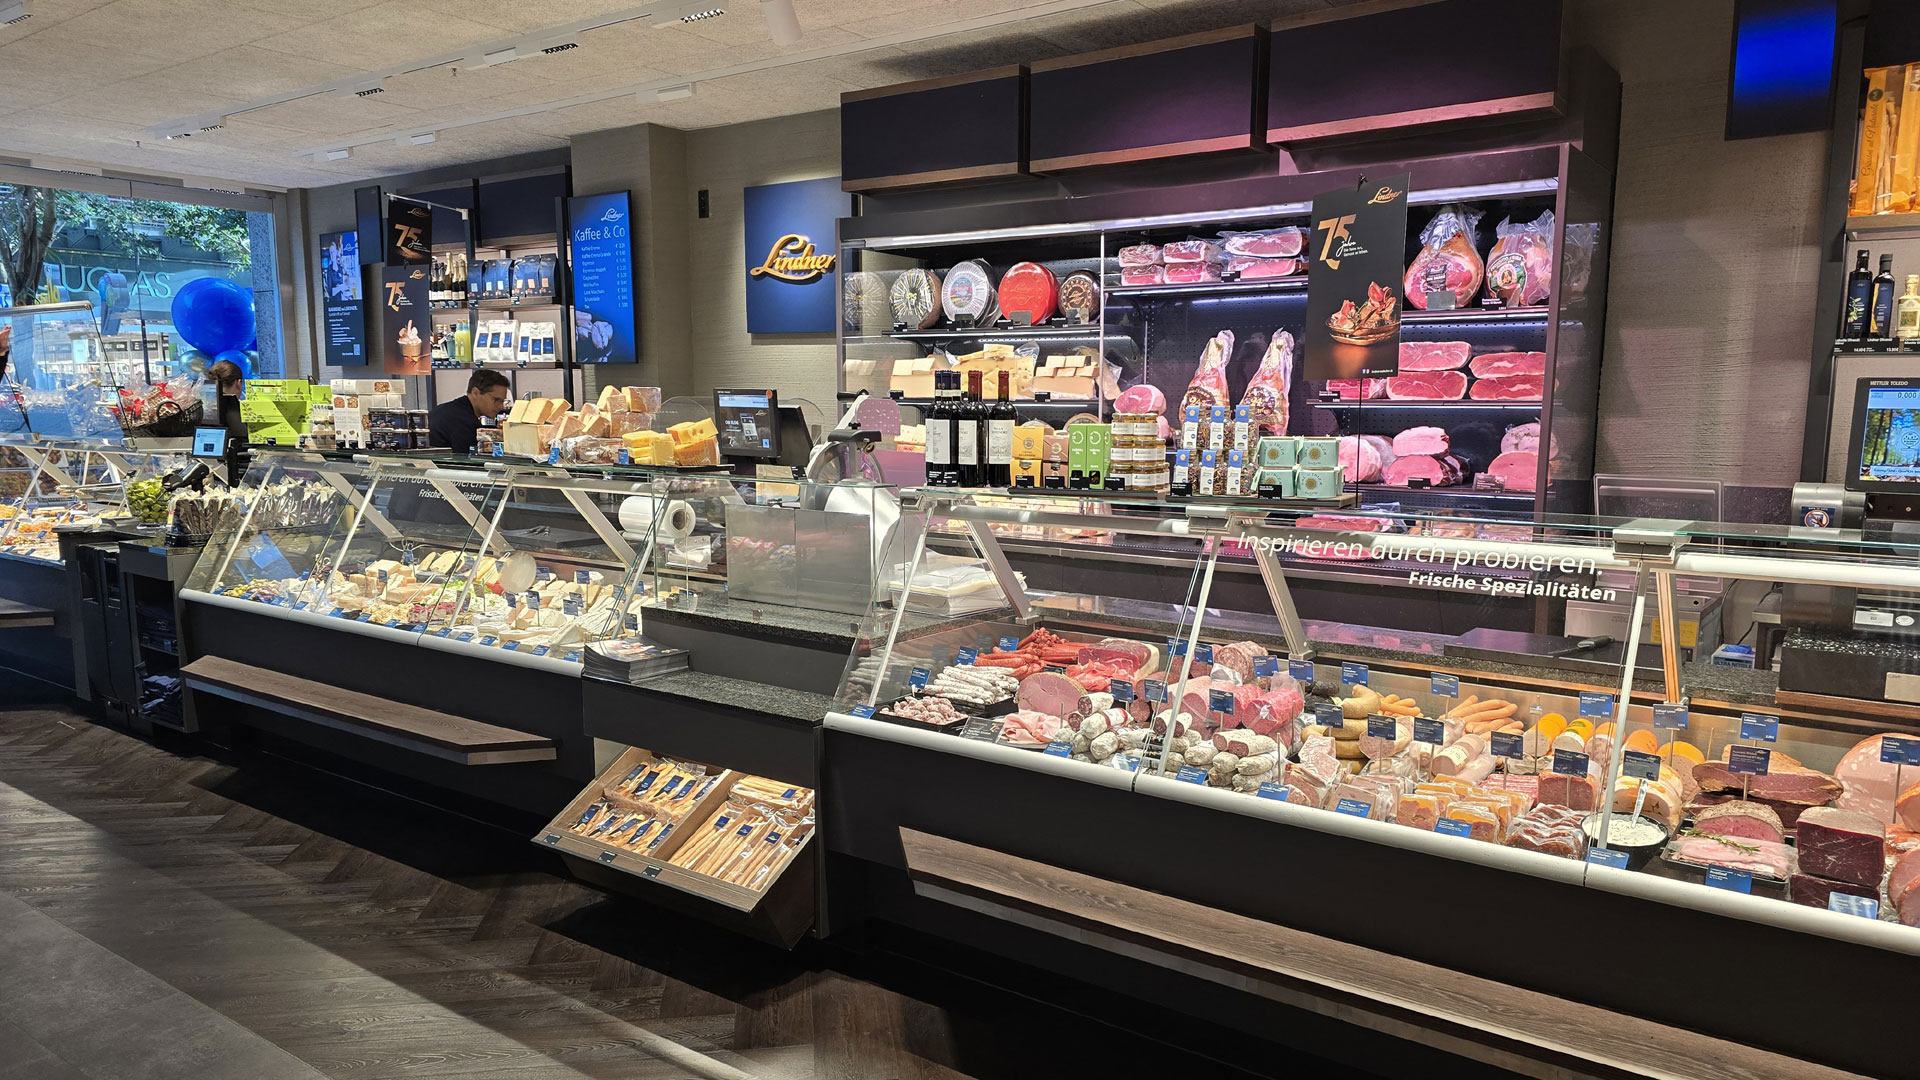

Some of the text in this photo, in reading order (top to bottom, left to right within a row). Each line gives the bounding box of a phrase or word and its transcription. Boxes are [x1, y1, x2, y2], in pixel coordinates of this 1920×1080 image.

[1368, 187, 1402, 204] Lindner
[394, 224, 422, 257] 75
[575, 226, 626, 242] Kaffee & Co
[1318, 214, 1356, 270] 75
[750, 234, 836, 280] Lindner
[385, 282, 406, 312] 75
[1238, 532, 1604, 575] Inspirieren durch probieren.
[1408, 572, 1616, 602] Frische Spezialitäten
